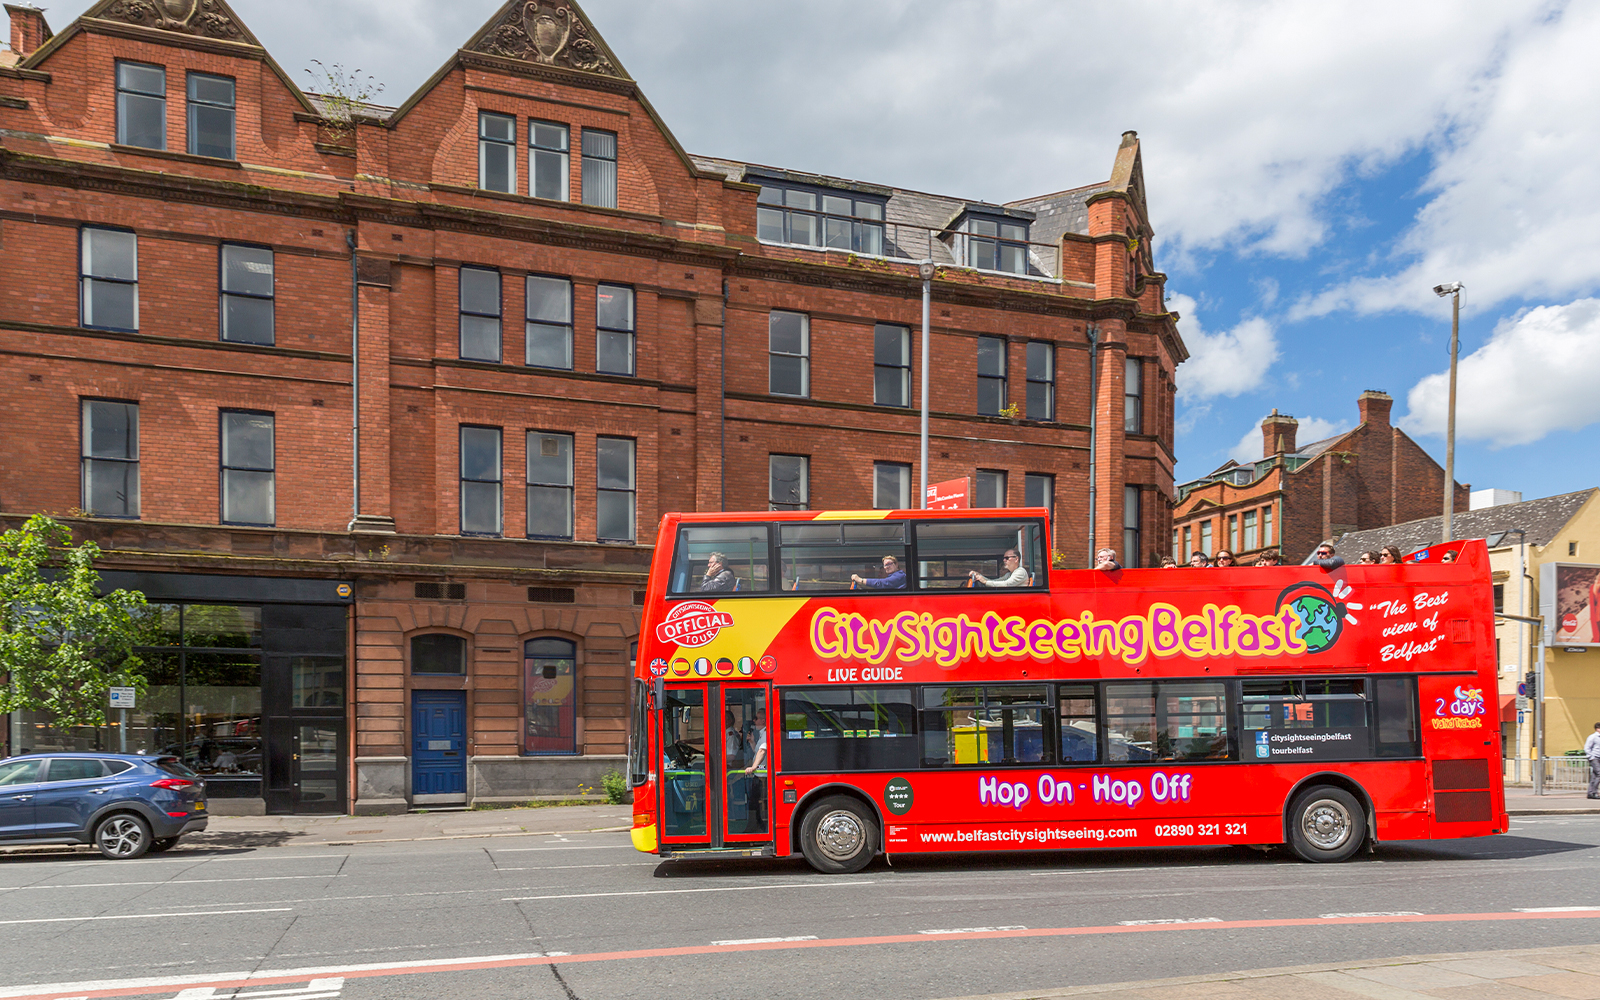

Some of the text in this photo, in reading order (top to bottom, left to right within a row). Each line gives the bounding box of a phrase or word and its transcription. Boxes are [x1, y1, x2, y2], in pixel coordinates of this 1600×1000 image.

[1413, 591, 1449, 610] Best
[664, 614, 730, 638] OFFICIAL
[1382, 611, 1439, 637] view of
[685, 630, 715, 644] TOUR
[827, 667, 903, 682] LIVE GUIDE
[1436, 698, 1486, 717] 2 days
[1270, 733, 1352, 742] citysightseeingbelfast
[979, 776, 1030, 809] Hop
[1037, 774, 1074, 804] On
[1092, 774, 1142, 807] Hop
[1150, 772, 1193, 801] Off
[920, 824, 1137, 843] www.belfastcitysightseeing.com
[1155, 824, 1194, 837] 02890
[1197, 824, 1220, 836] 321
[1225, 823, 1247, 835] 321
